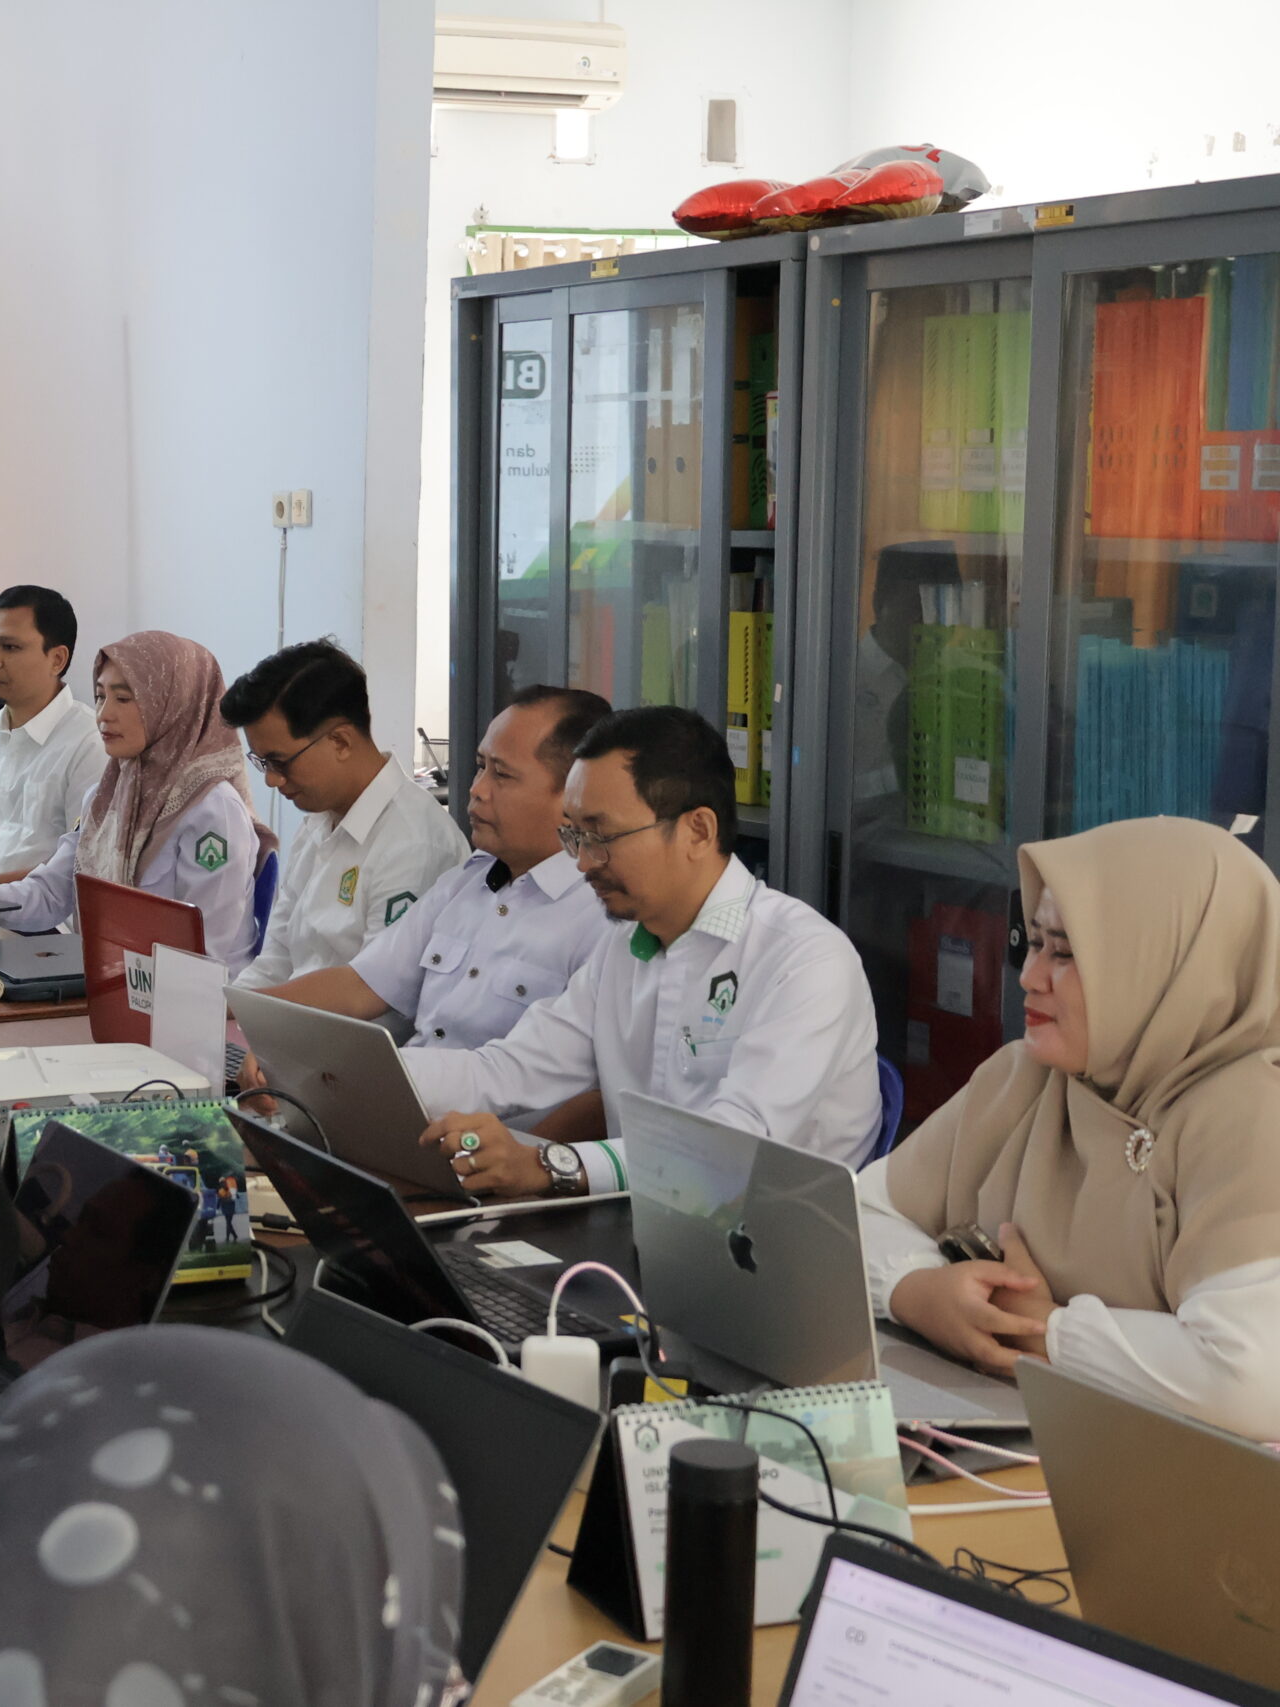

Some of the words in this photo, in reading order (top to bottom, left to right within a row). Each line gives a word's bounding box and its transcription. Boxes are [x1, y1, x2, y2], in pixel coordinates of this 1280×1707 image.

[128, 967, 152, 993] UIN
[131, 995, 152, 1009] PALOP
[758, 1468, 780, 1480] PO
